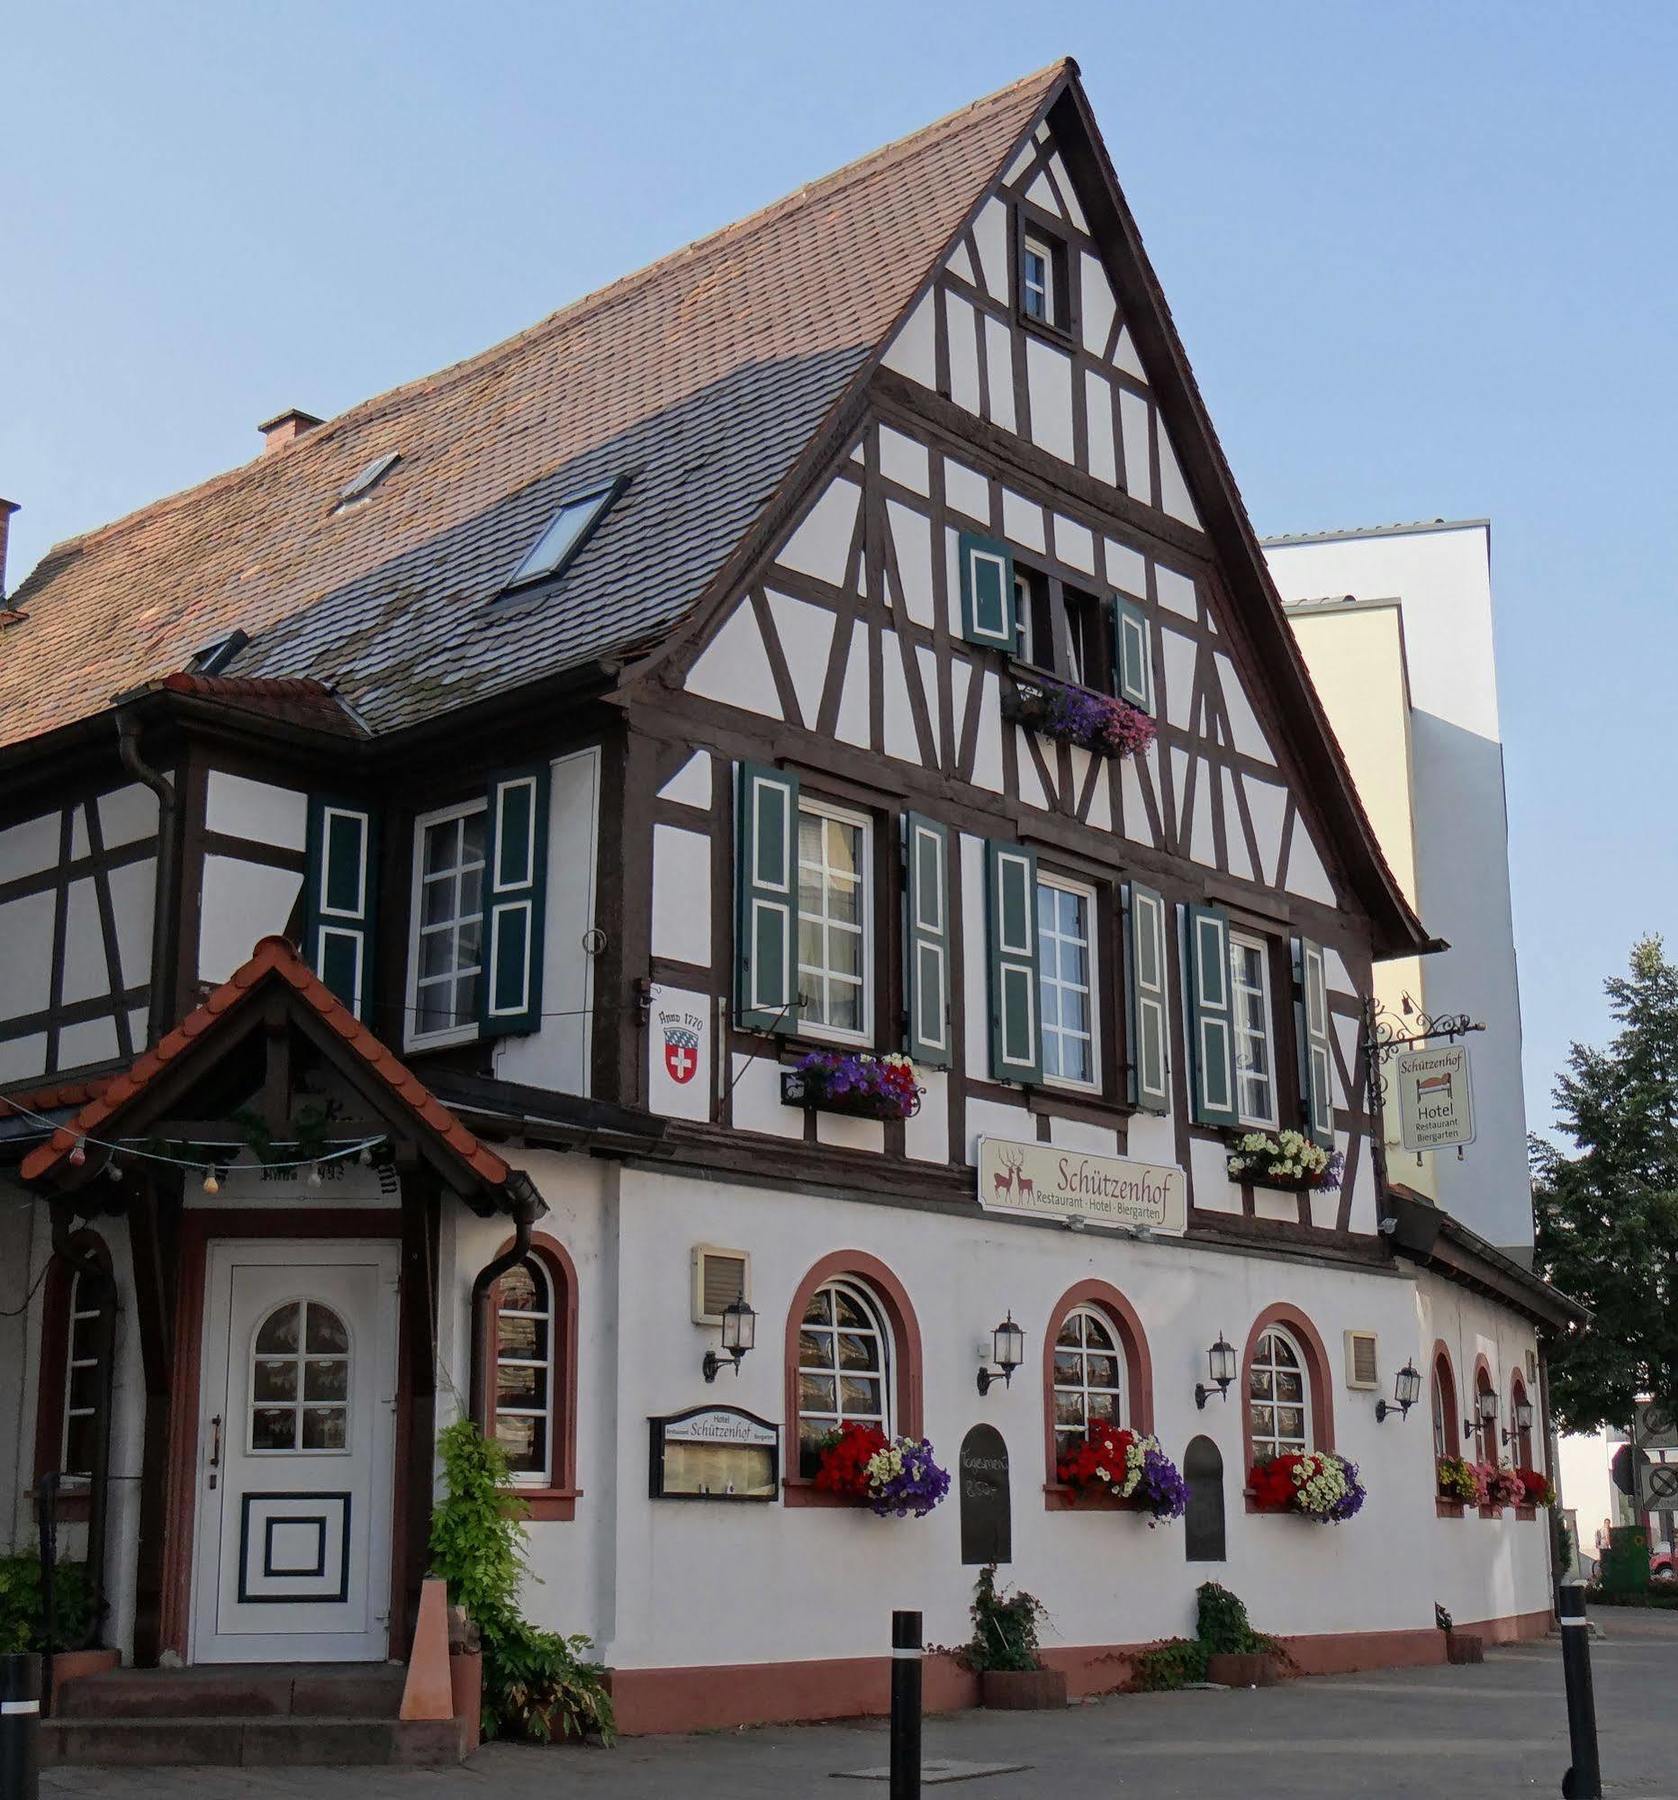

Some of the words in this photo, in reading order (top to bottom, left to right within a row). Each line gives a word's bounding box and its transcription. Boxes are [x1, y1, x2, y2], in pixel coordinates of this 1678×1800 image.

[659, 1011, 680, 1024] Anno
[684, 1013, 704, 1031] 1770
[1418, 1102, 1454, 1120] Hotel
[1415, 1119, 1458, 1132] Restaurant
[1416, 1130, 1459, 1143] Biergarten
[1057, 1157, 1173, 1225] Schützenhof
[1036, 1190, 1083, 1209] Restaurant
[1089, 1201, 1112, 1213] Hotel
[1117, 1203, 1160, 1219] Biergarten
[690, 1420, 752, 1441] Schützenhof
